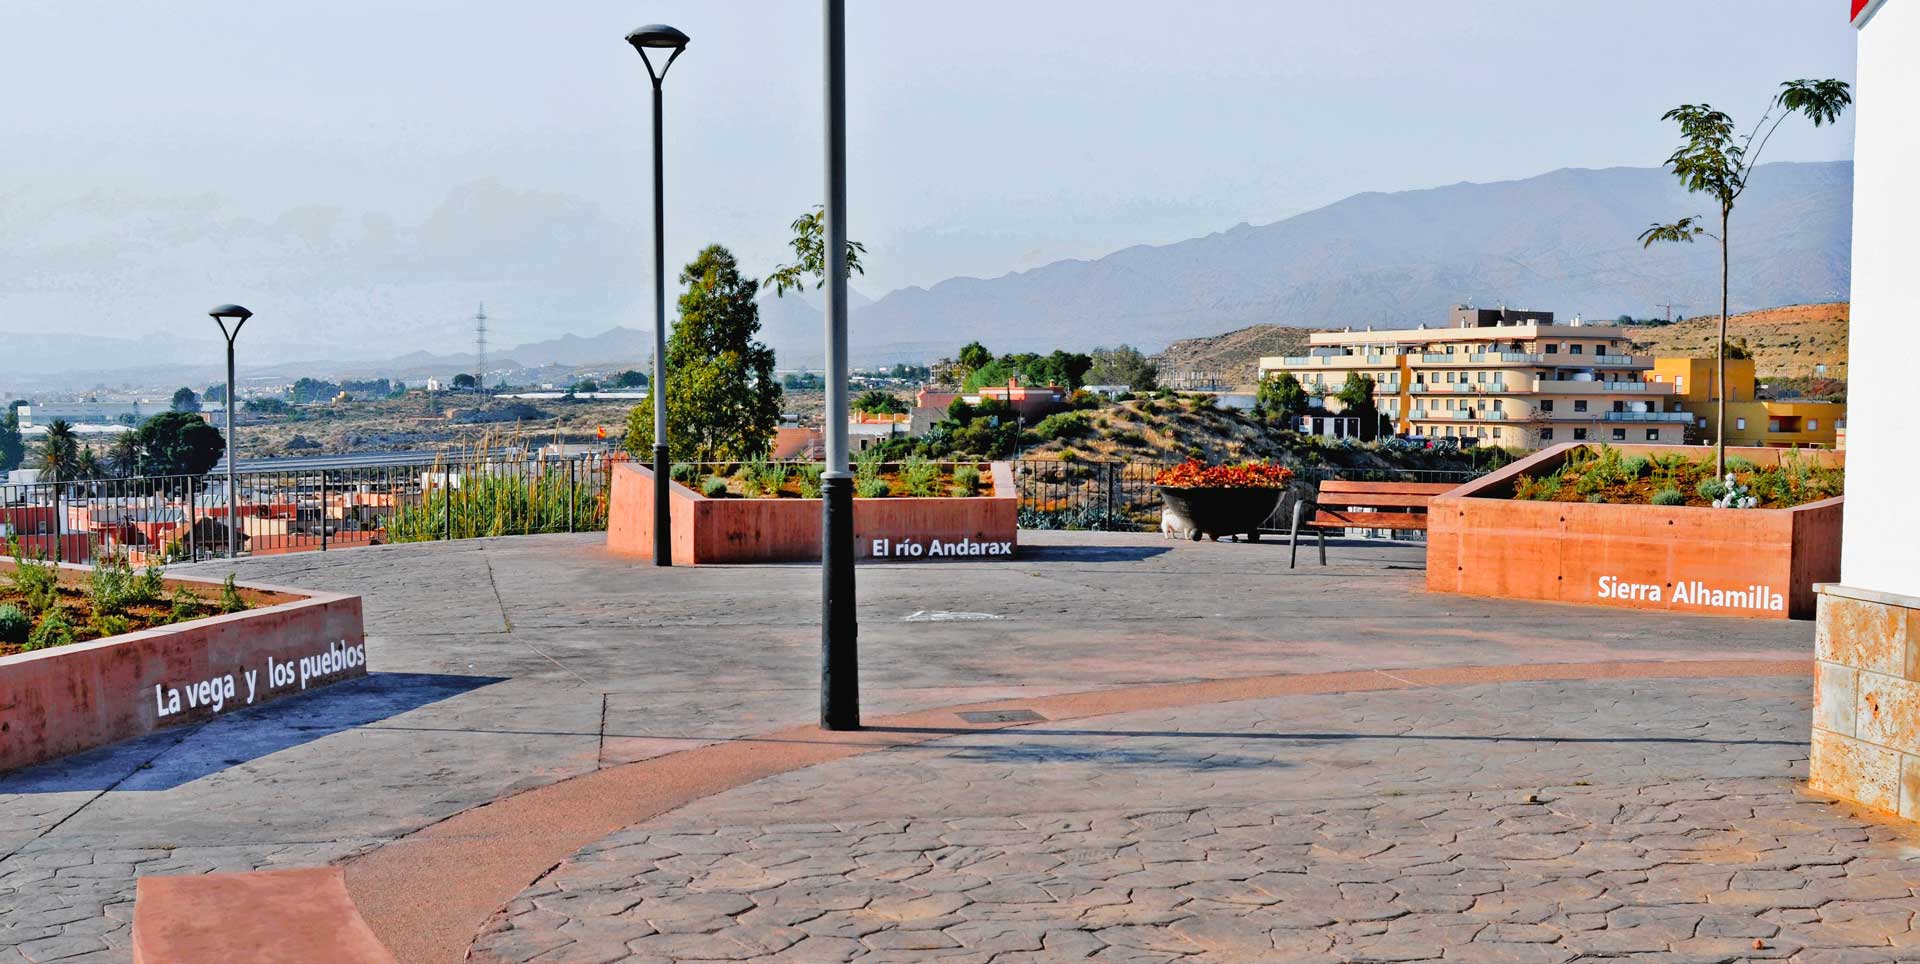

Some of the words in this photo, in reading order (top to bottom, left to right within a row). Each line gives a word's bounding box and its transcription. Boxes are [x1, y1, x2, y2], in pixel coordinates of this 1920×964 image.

[872, 538, 889, 556] El
[895, 538, 923, 556] río
[928, 538, 1012, 556] Andarax
[1597, 575, 1662, 602] Sierra
[1671, 581, 1785, 611] Alhamilla
[155, 684, 181, 717] La
[185, 674, 235, 712] vega
[245, 669, 257, 704] y
[268, 656, 295, 688] los
[300, 639, 365, 690] pueblos
